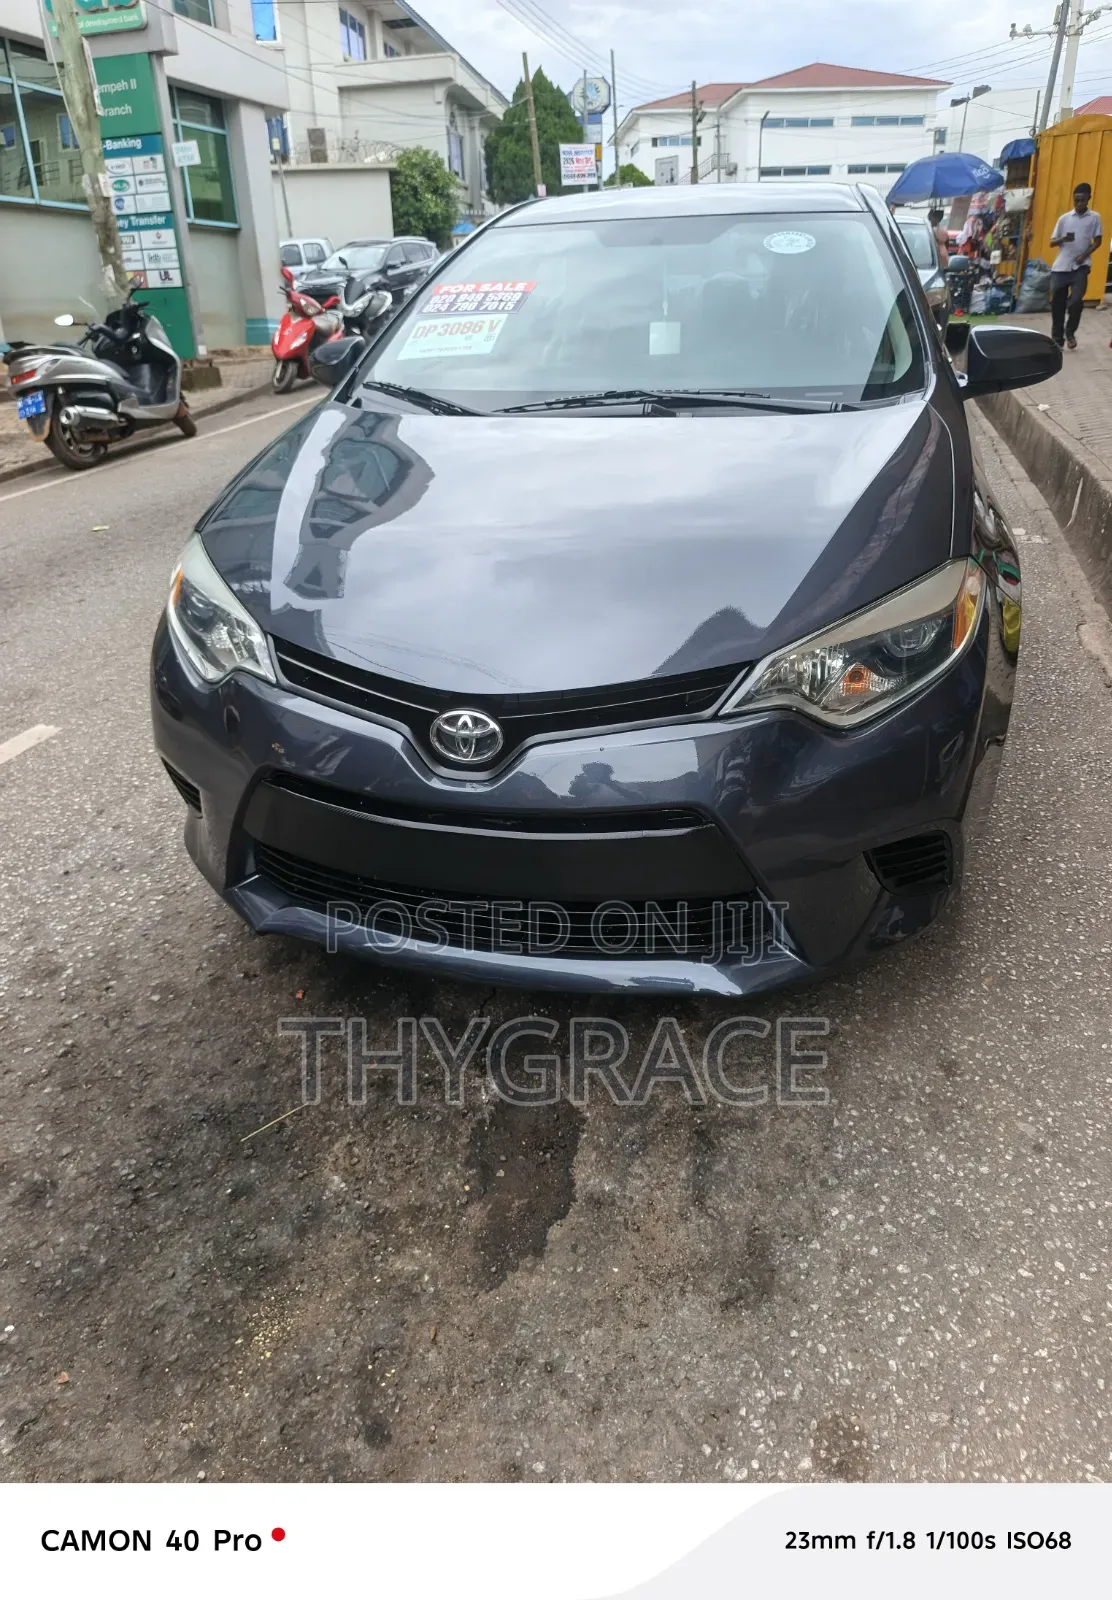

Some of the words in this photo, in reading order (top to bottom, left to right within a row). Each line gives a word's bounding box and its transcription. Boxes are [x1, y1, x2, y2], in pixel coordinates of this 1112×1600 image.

[97, 80, 129, 94] empeh
[99, 104, 132, 117] ranch
[102, 138, 142, 150] -Banking
[130, 214, 166, 227] Transfer
[439, 284, 477, 294] FOR
[479, 282, 528, 292] SALE
[479, 302, 516, 312] 7015
[412, 325, 438, 339] DP
[437, 320, 485, 336] 3086
[487, 319, 501, 333] V
